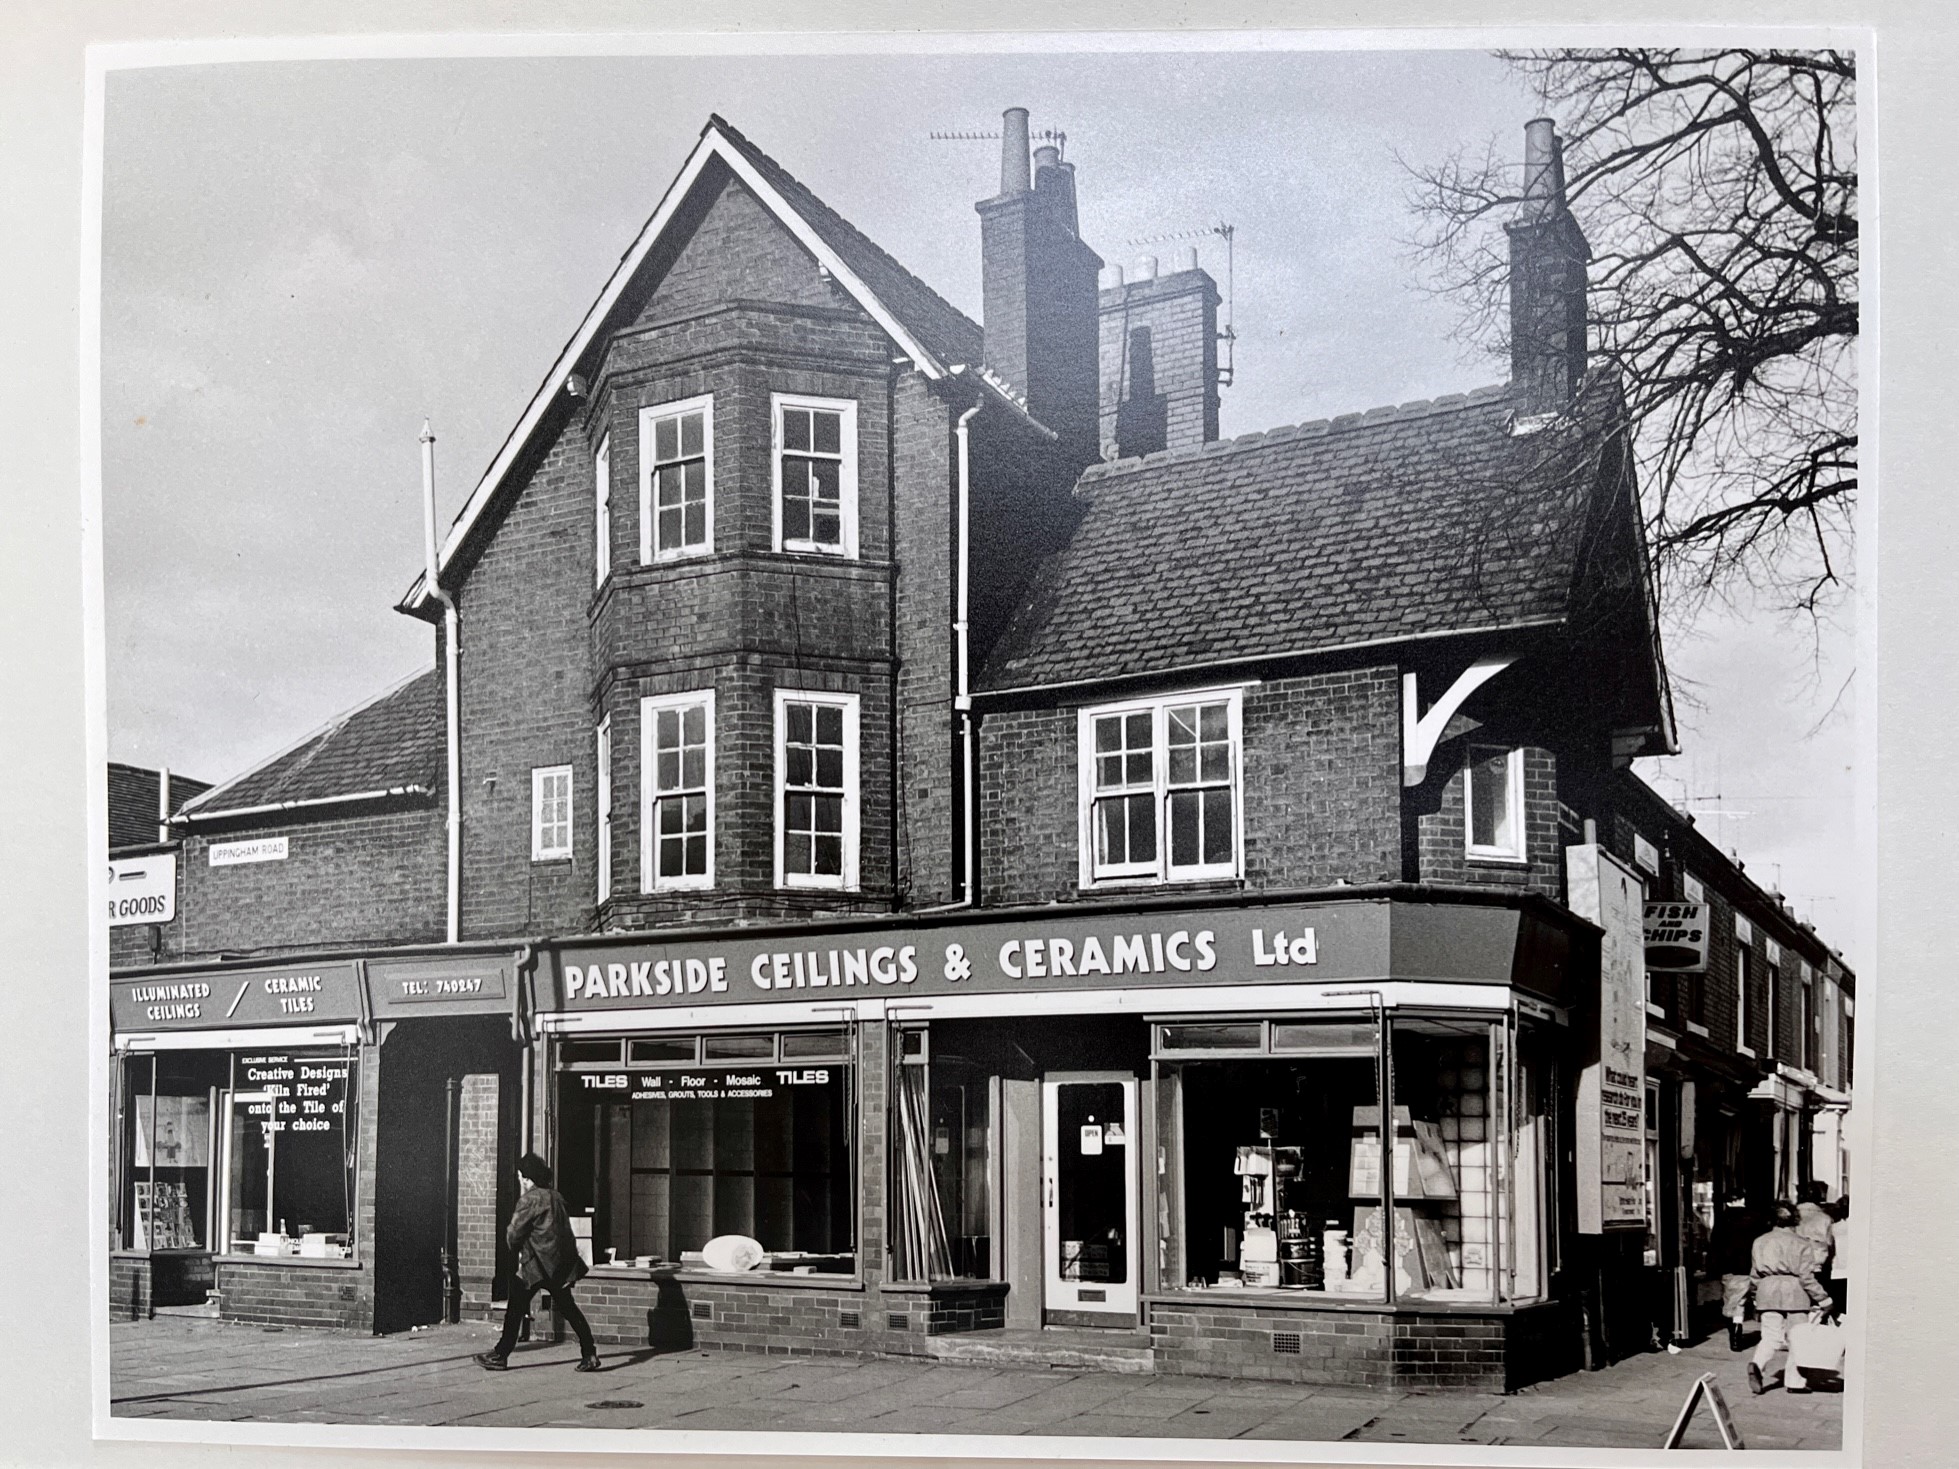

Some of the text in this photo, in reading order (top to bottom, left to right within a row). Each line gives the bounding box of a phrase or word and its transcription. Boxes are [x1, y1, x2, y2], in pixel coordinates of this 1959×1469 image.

[212, 843, 284, 861] UPPINGHAM ROAD
[119, 895, 165, 917] GOODS
[1643, 906, 1699, 919] FISH
[1657, 920, 1683, 928] AND
[564, 927, 1318, 1000] PARKSIDE CEILINGS & CERAMICS Ltd
[131, 982, 212, 1002] ILLUMINATED
[264, 976, 323, 994] CERAMIC
[402, 978, 483, 995] TEL: 740247
[147, 1003, 202, 1021] CEILINGS
[280, 996, 315, 1014] TILES
[247, 1065, 349, 1081] Creative Designs
[581, 1074, 628, 1089] TILES
[640, 1076, 662, 1088] Wall
[680, 1075, 707, 1088] Floor
[725, 1073, 762, 1087] Mosaic
[775, 1069, 830, 1085] TILES
[697, 1090, 719, 1098] TOOLS
[727, 1089, 773, 1098] ACCESSORIES
[248, 1099, 345, 1115] onto the Tile of
[260, 1117, 331, 1135] your choice
